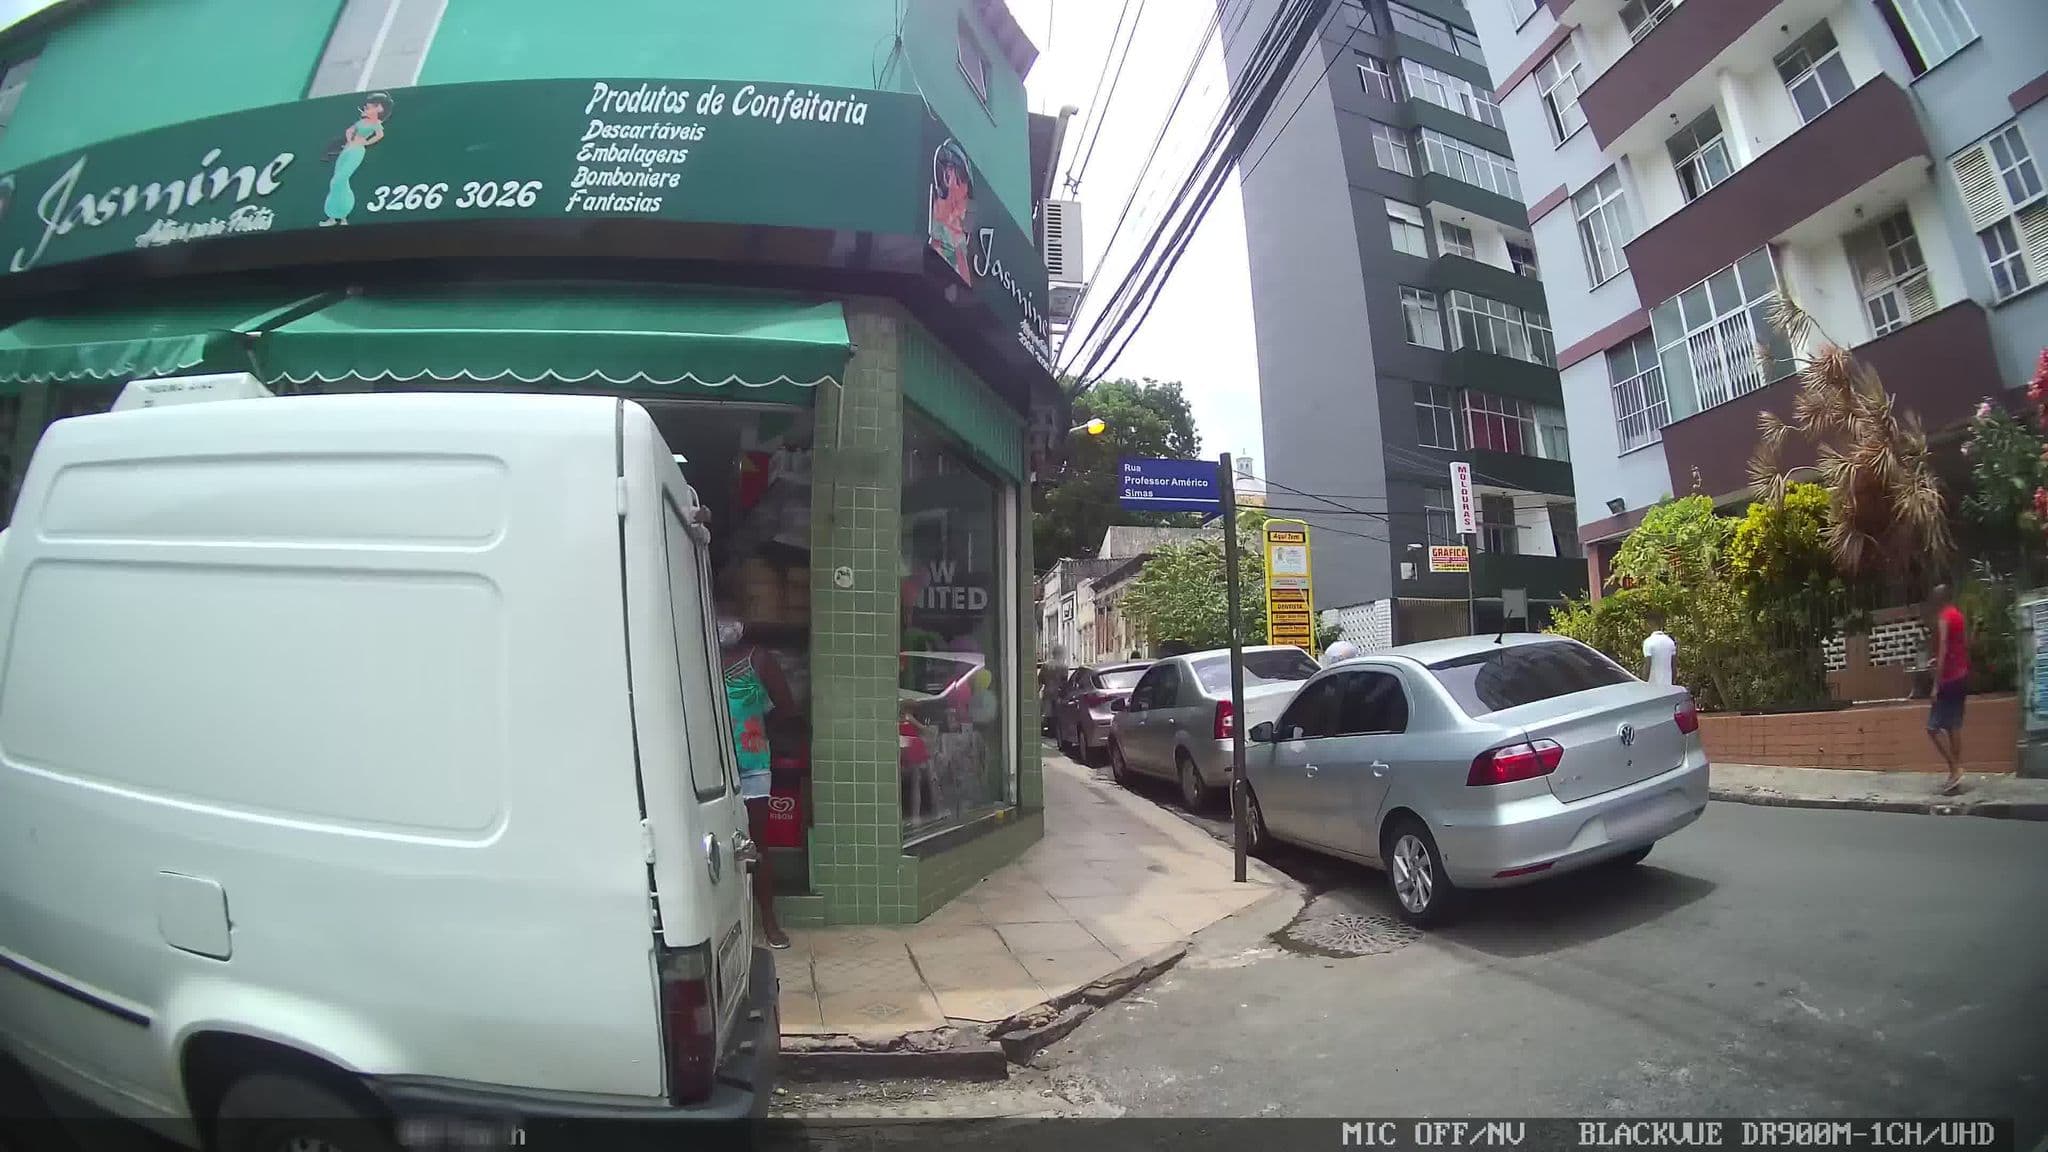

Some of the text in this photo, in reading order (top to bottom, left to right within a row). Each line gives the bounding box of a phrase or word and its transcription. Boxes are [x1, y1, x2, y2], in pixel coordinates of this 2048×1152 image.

[585, 82, 869, 126] Produtos de Confeitaria
[581, 119, 706, 142] Descartáveis
[576, 142, 688, 168] Embalagens
[570, 166, 681, 189] Bomboniere
[366, 180, 543, 211] 3266 3026
[565, 188, 662, 213] Fantasias
[9, 148, 295, 272] Jasmine
[973, 227, 1048, 337] Jasmine
[1124, 463, 1141, 472] Rua
[1124, 476, 1208, 487] Professor Américo
[1124, 488, 1153, 498] Simas
[1458, 466, 1471, 525] MOLDURAS
